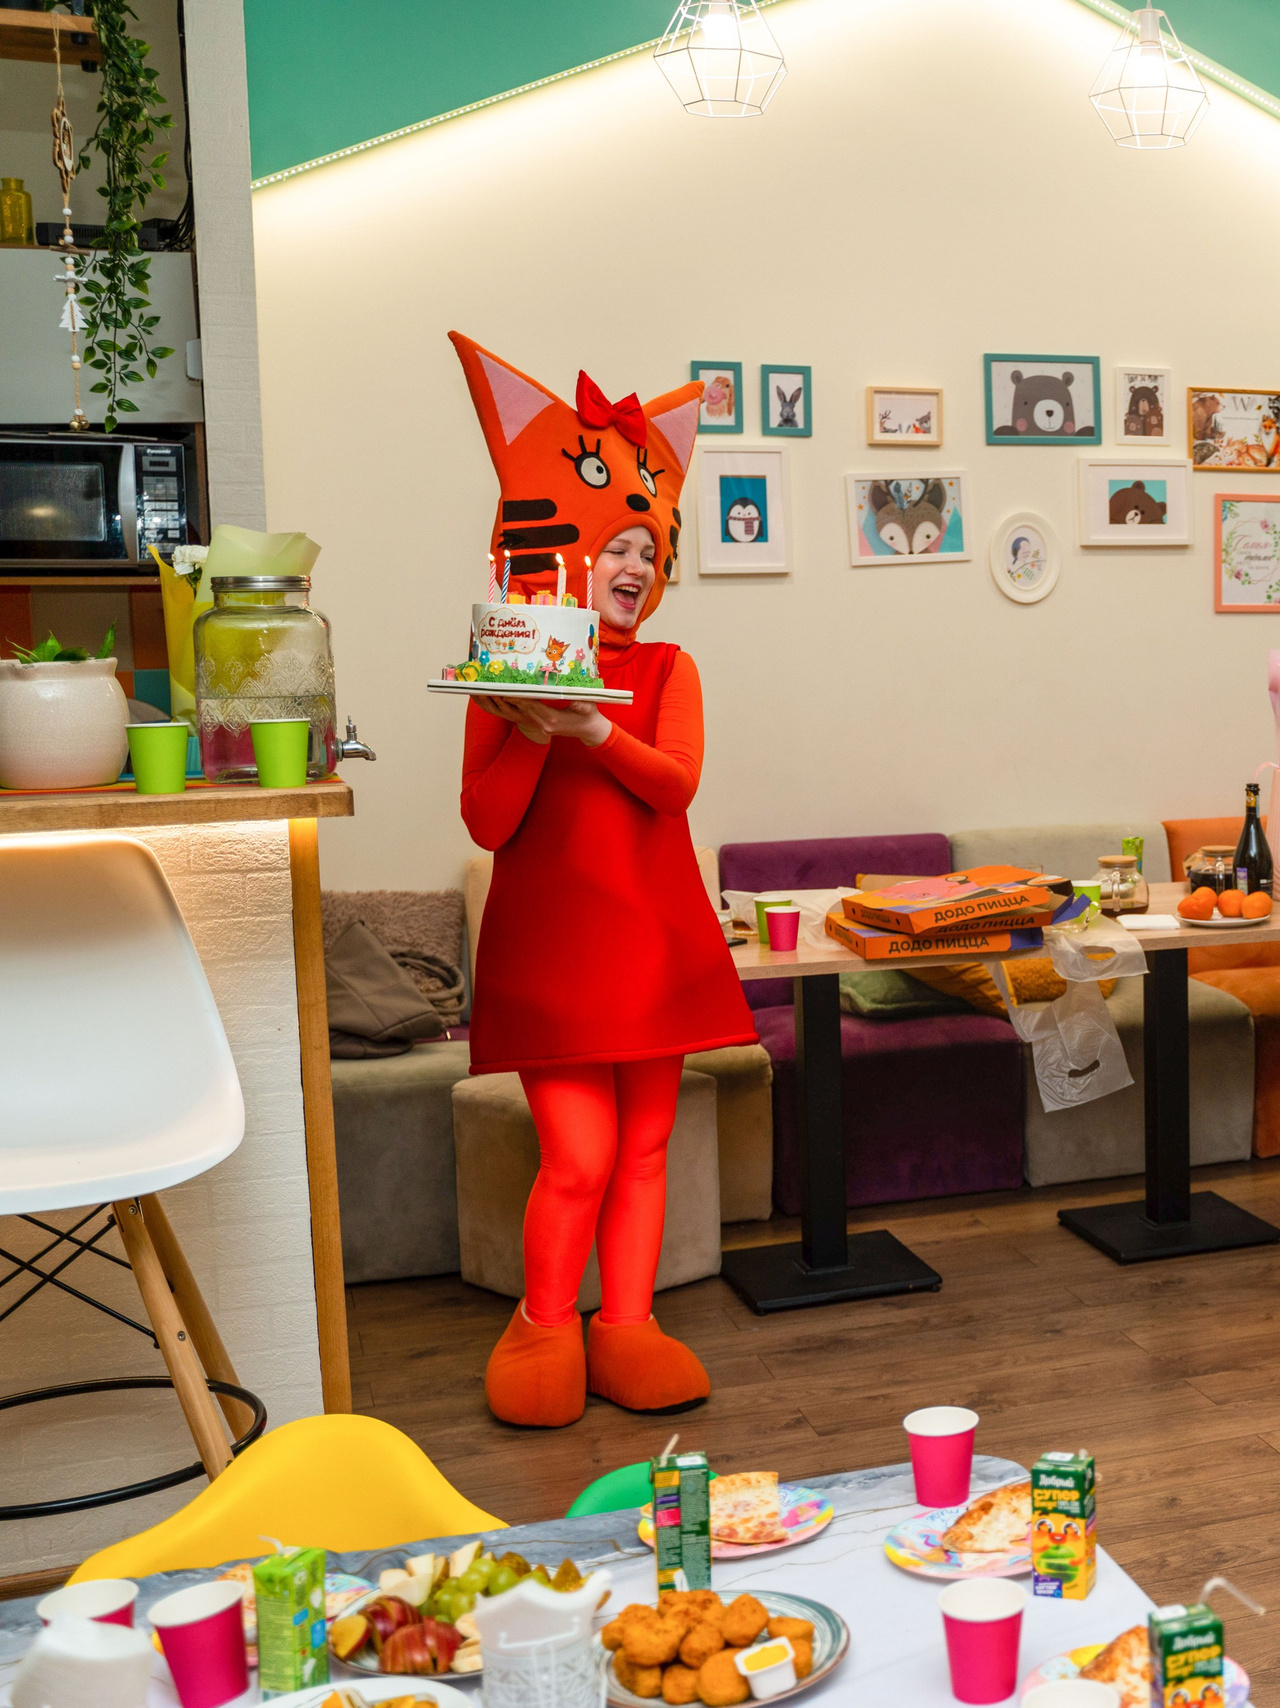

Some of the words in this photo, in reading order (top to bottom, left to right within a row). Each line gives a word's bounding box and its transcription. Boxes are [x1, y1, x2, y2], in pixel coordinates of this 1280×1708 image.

[934, 905, 975, 923] ДОДО
[976, 895, 1030, 912] ПИЦЦА
[982, 916, 1035, 928] ПИЦЦА
[888, 938, 933, 954] ДОДО
[934, 936, 989, 949] ПИЦЦА
